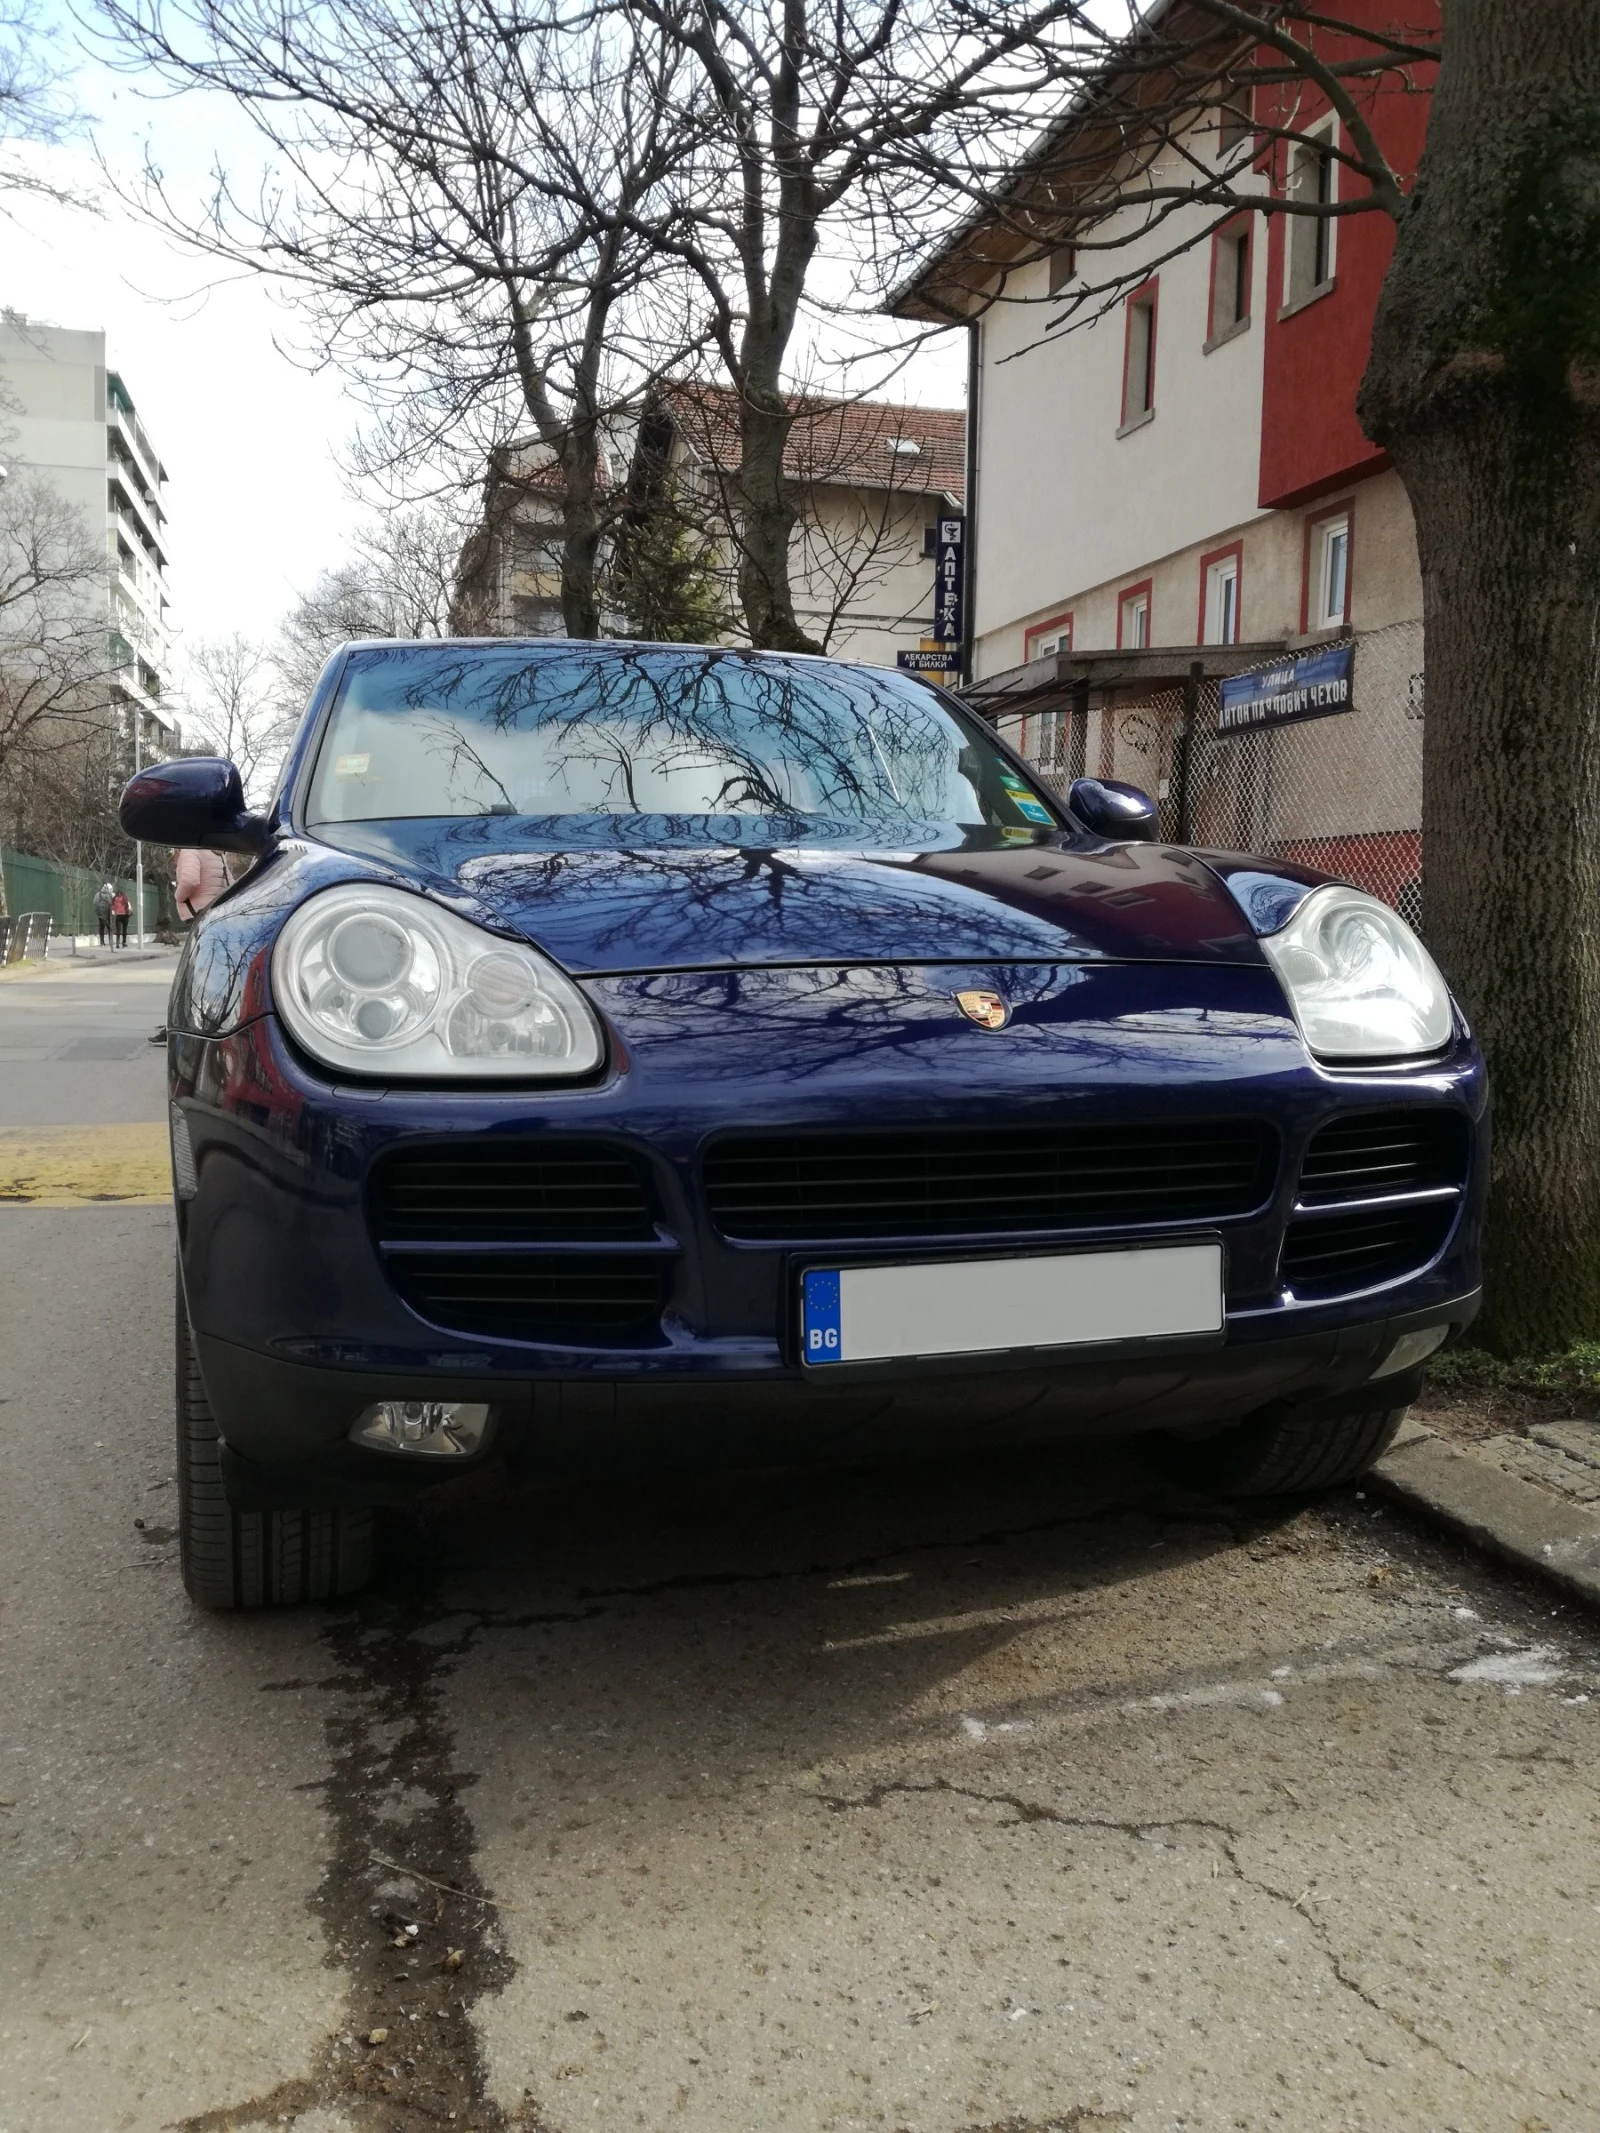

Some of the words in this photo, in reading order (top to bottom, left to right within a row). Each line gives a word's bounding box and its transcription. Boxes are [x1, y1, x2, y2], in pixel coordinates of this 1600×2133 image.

[943, 546, 957, 637] АПТЕКА
[904, 653, 953, 661] ЛЕКАРСТВА
[909, 660, 916, 668] И
[918, 660, 947, 668] БИЛКИ
[1261, 668, 1295, 688] УЛИЦА
[1218, 703, 1250, 729] АНТОН
[1310, 679, 1348, 707] ЧЕХОВ
[810, 1328, 838, 1349] BG
